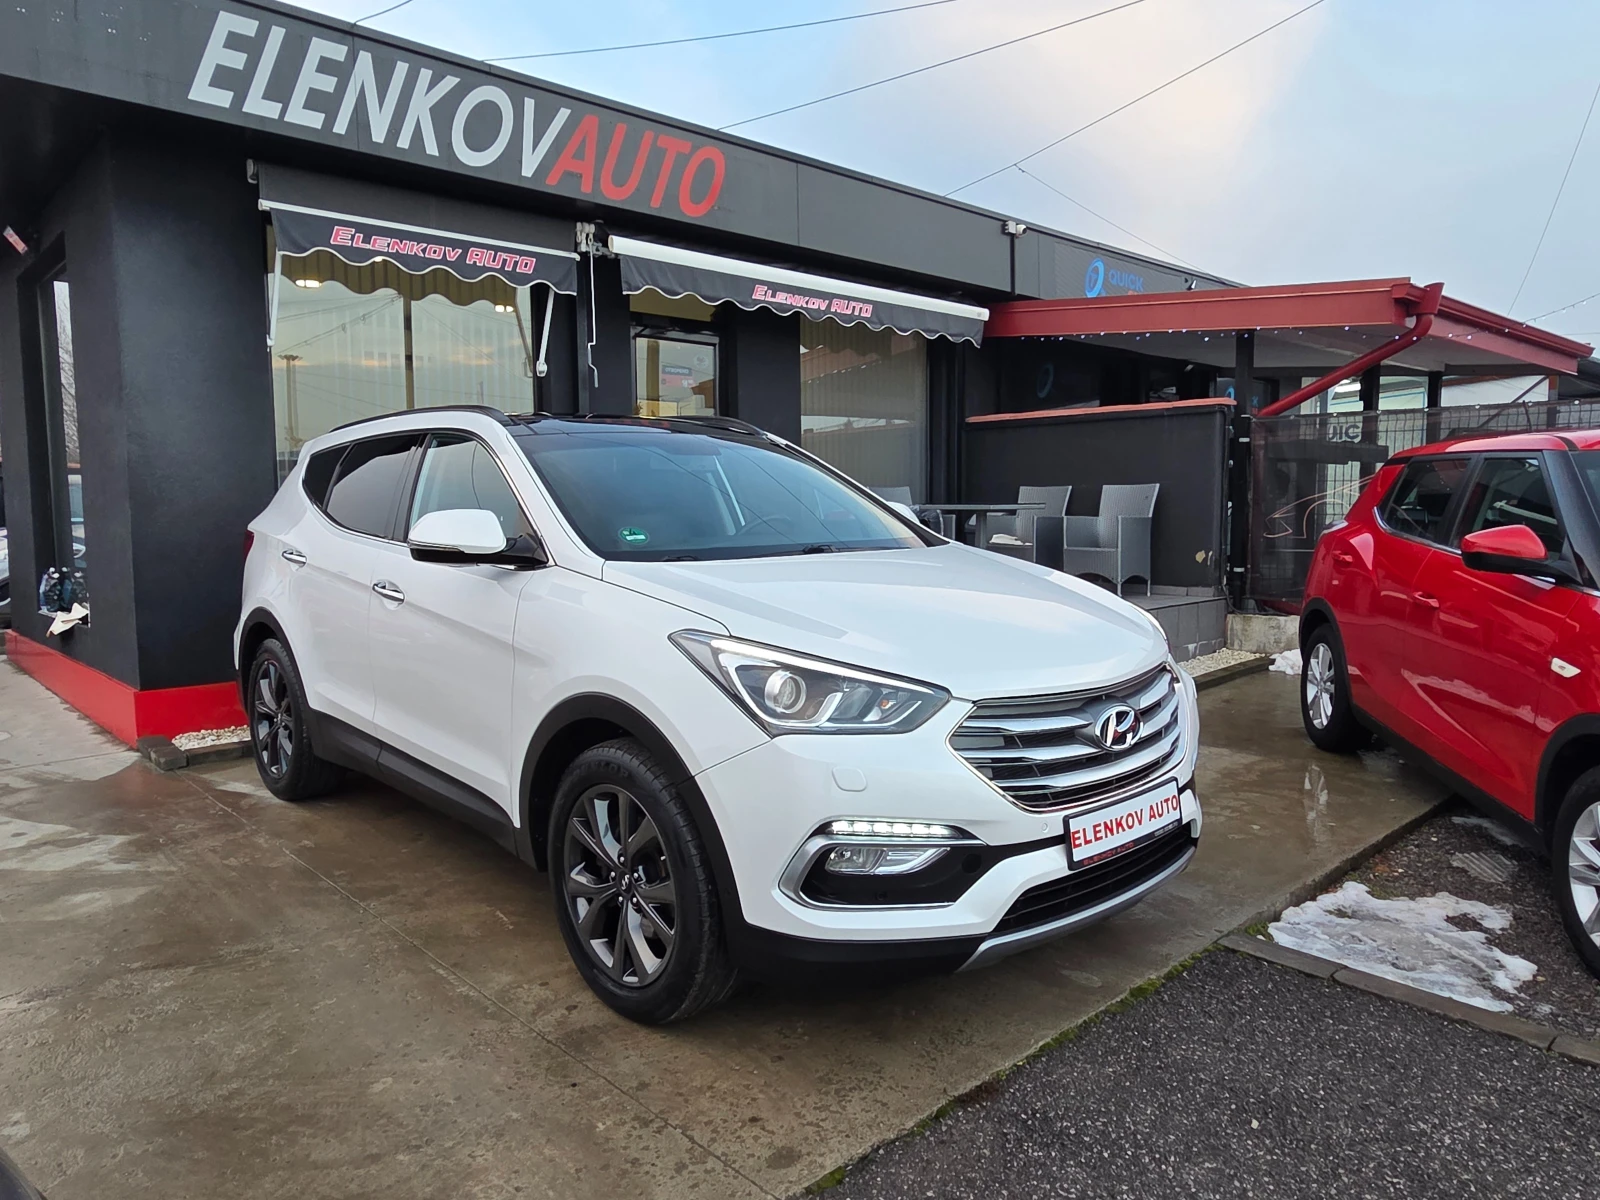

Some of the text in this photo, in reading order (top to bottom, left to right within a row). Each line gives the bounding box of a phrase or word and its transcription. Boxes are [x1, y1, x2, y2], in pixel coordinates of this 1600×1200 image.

[330, 226, 536, 274] ELENKOV AUTO
[752, 284, 873, 318] ELENKOV AUTO
[1109, 269, 1144, 292] QUICK
[1071, 809, 1143, 849] ELENKOV
[1149, 795, 1179, 821] AUTO
